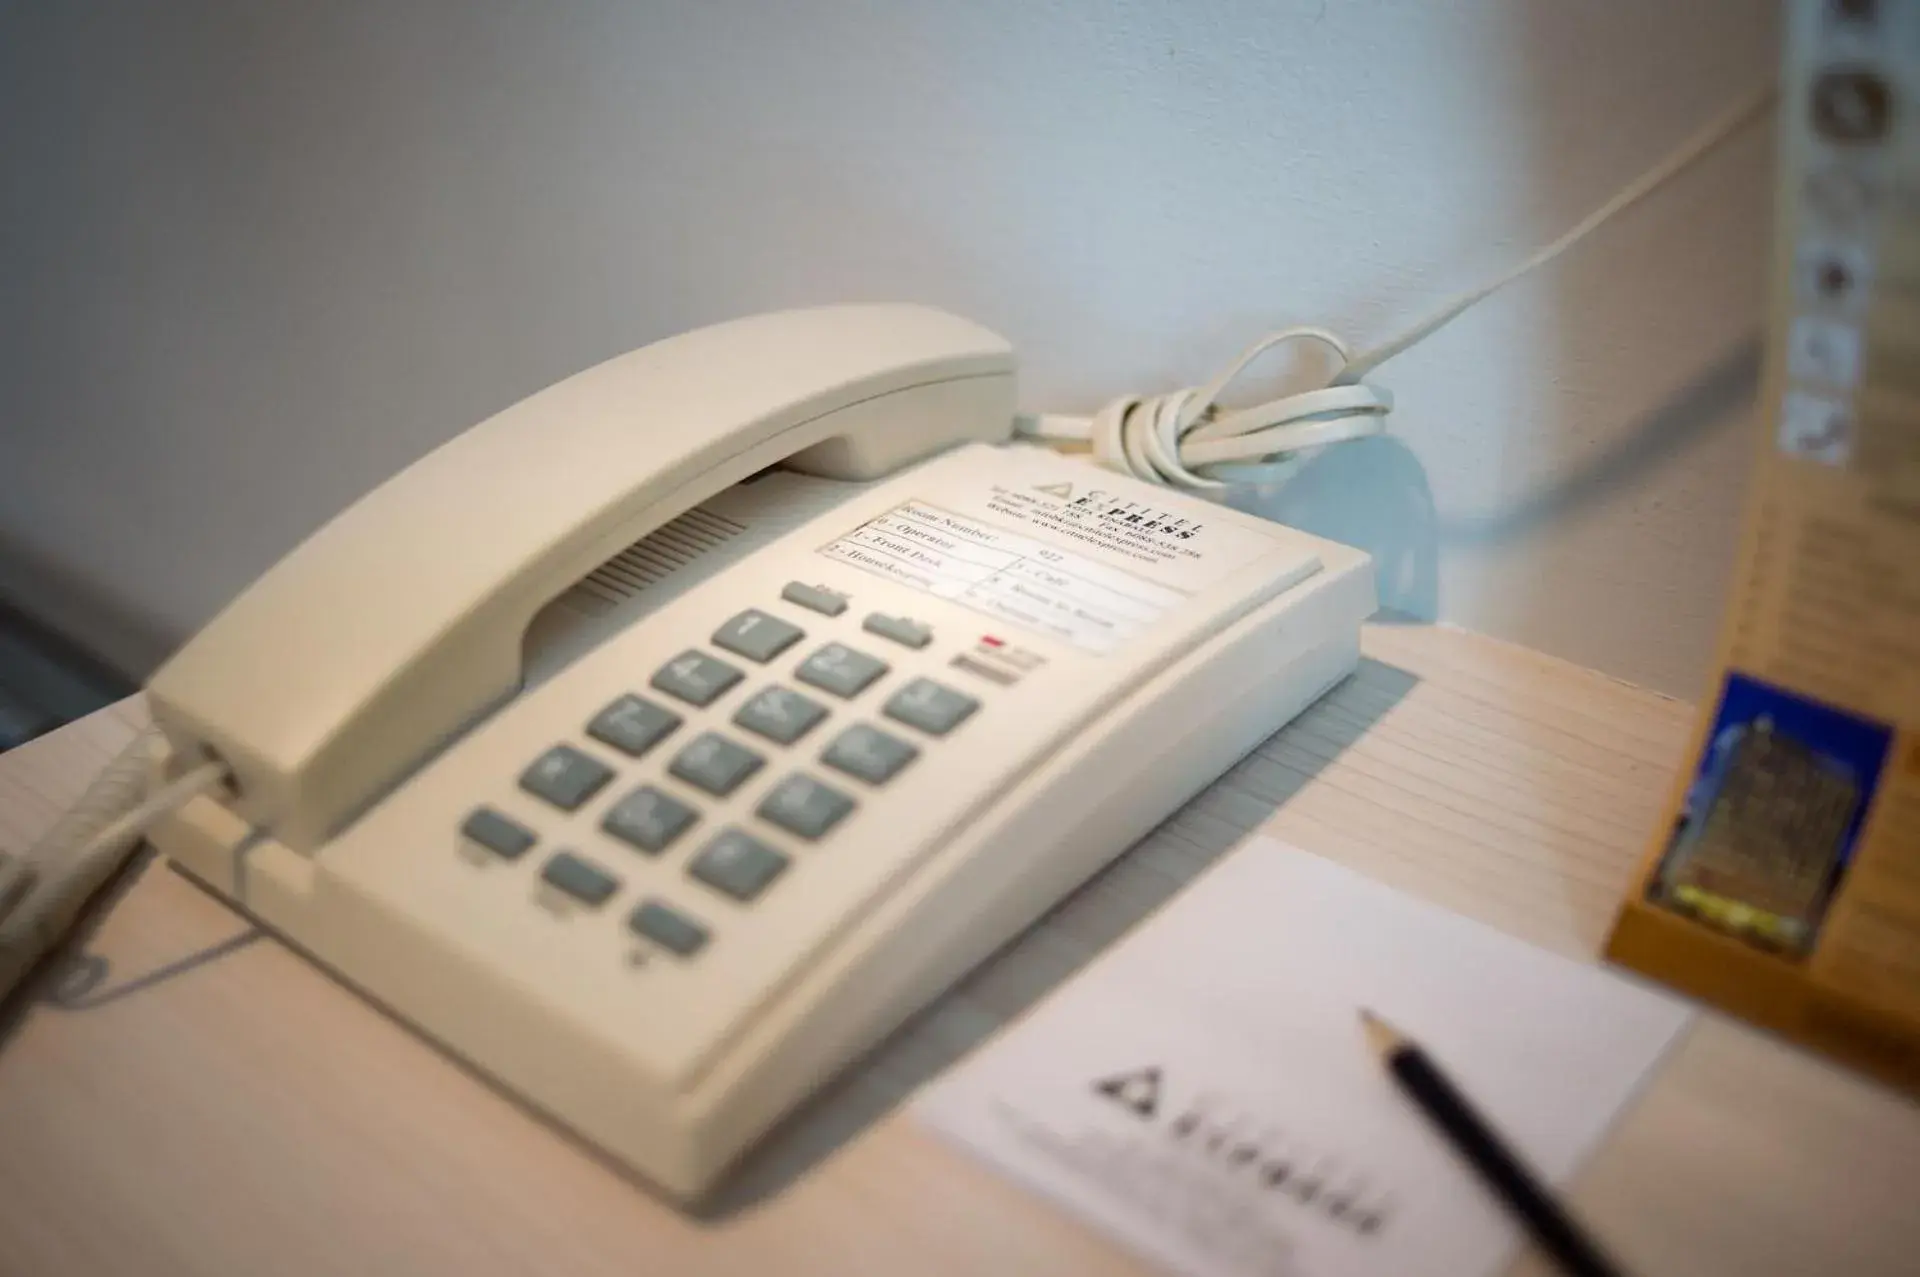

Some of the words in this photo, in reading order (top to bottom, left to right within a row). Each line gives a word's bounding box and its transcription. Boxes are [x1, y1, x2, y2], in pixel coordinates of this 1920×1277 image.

[902, 505, 941, 521] Room
[1074, 497, 1196, 539] EXPRESS
[1087, 490, 1203, 530] CITITEL
[872, 536, 911, 554] Front
[896, 524, 956, 550] Operator
